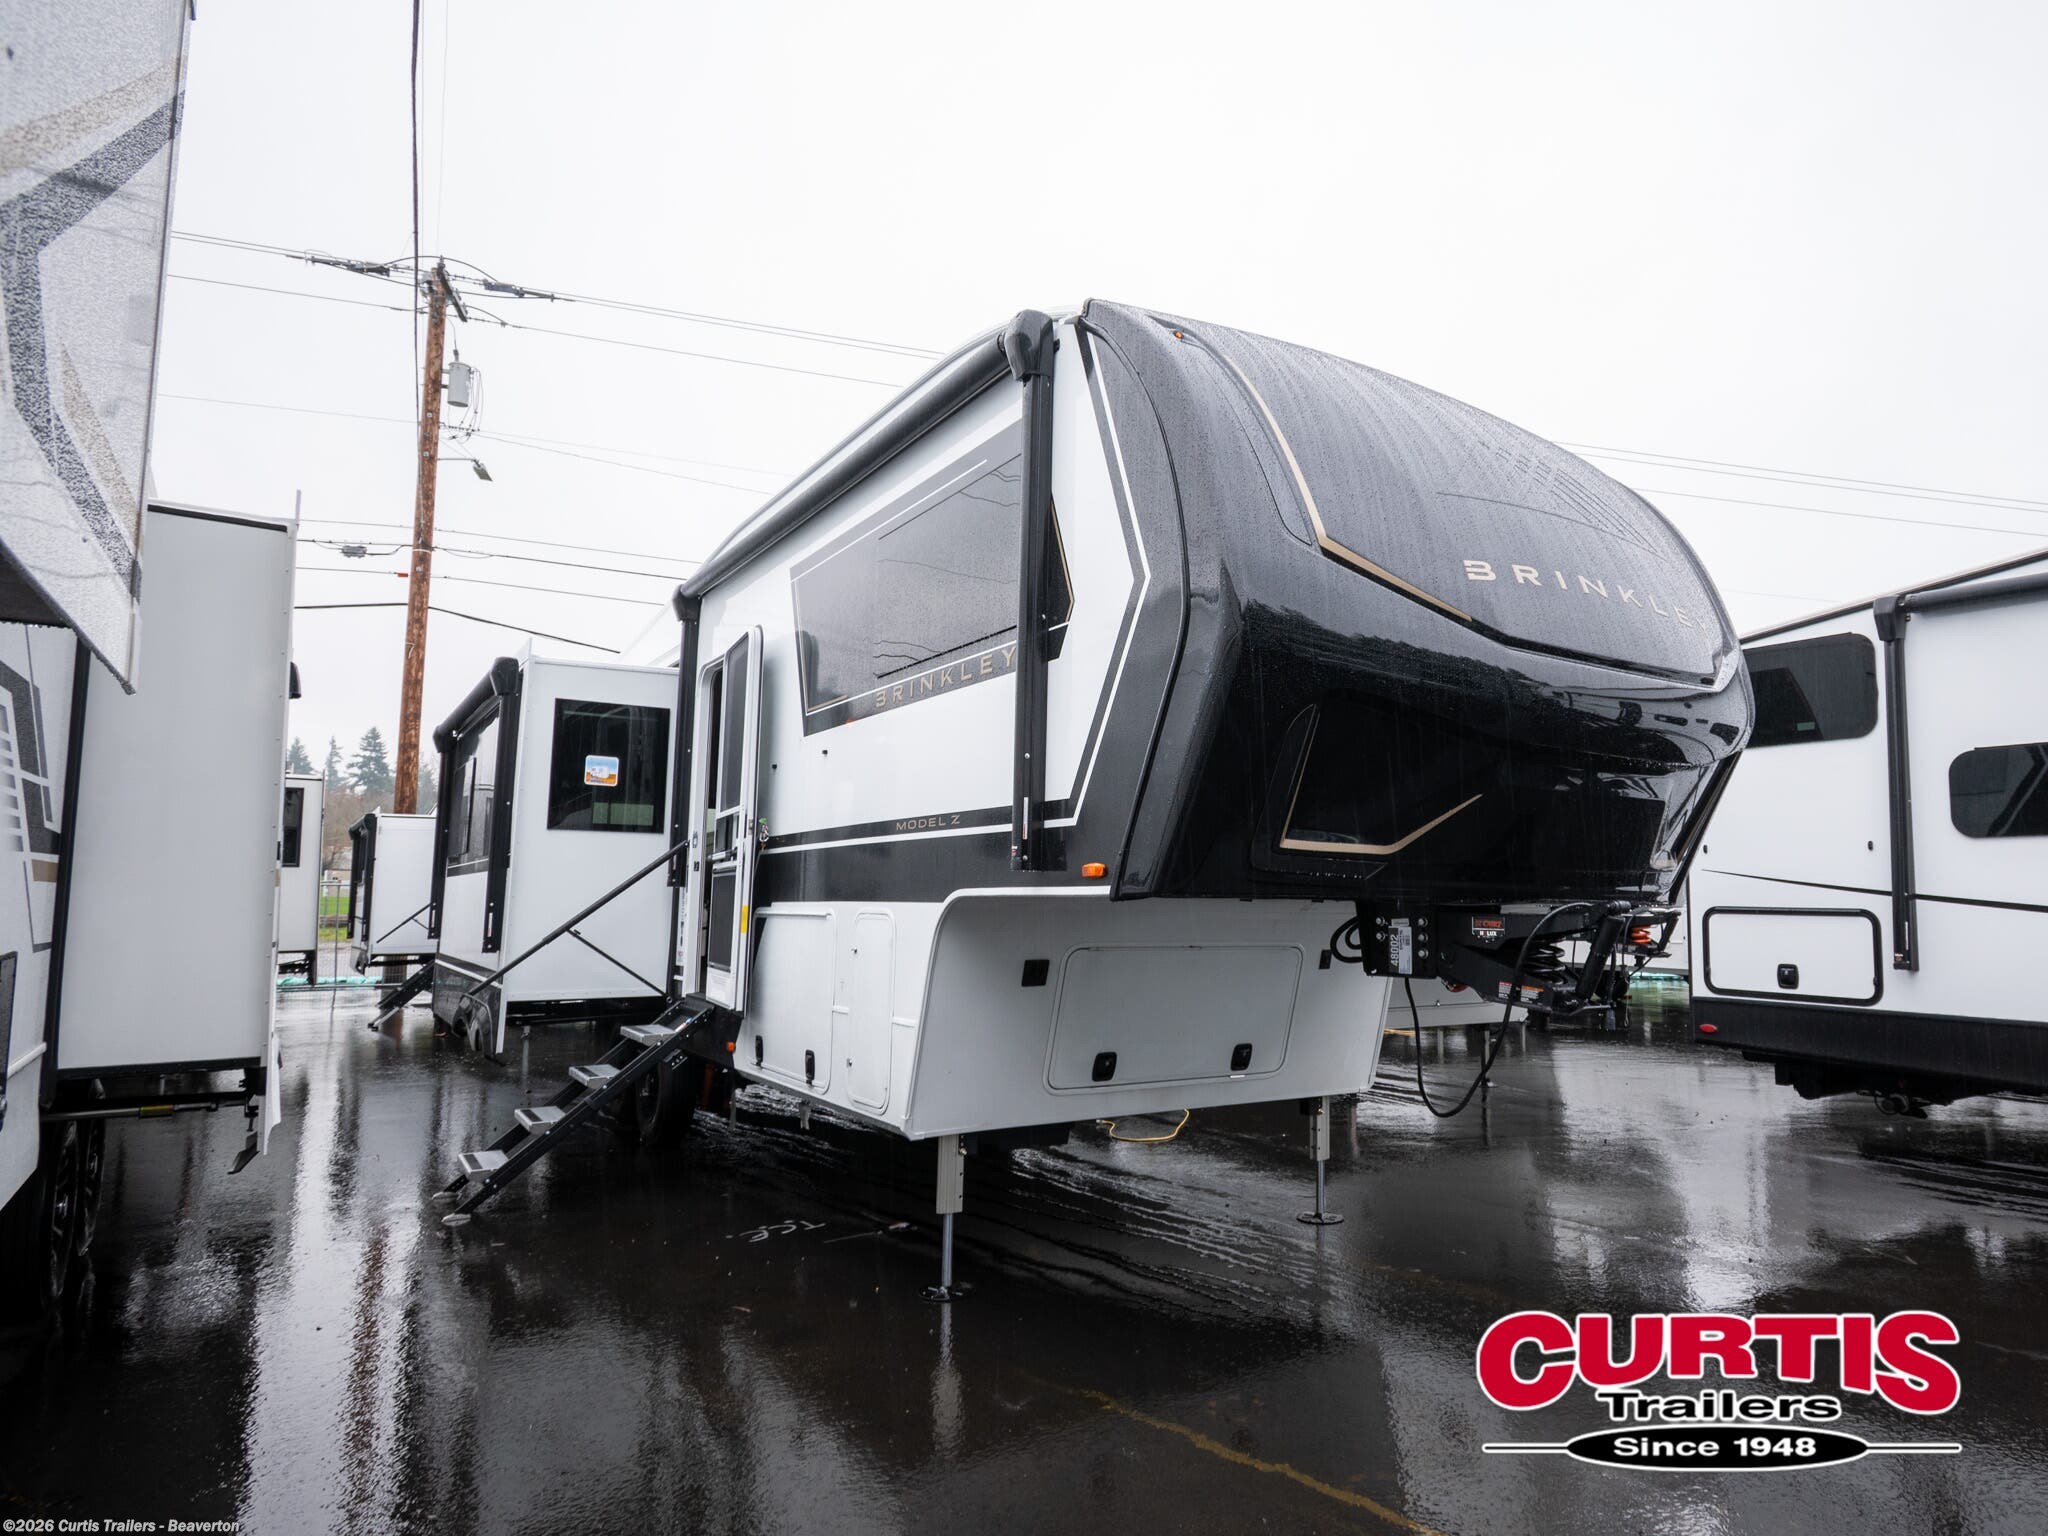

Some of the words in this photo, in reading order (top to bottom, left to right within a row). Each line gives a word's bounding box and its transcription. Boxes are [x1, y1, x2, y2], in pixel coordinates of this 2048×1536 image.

[875, 646, 1017, 708] BRINKLEY
[896, 816, 946, 831] MODEL
[950, 814, 961, 825] Z
